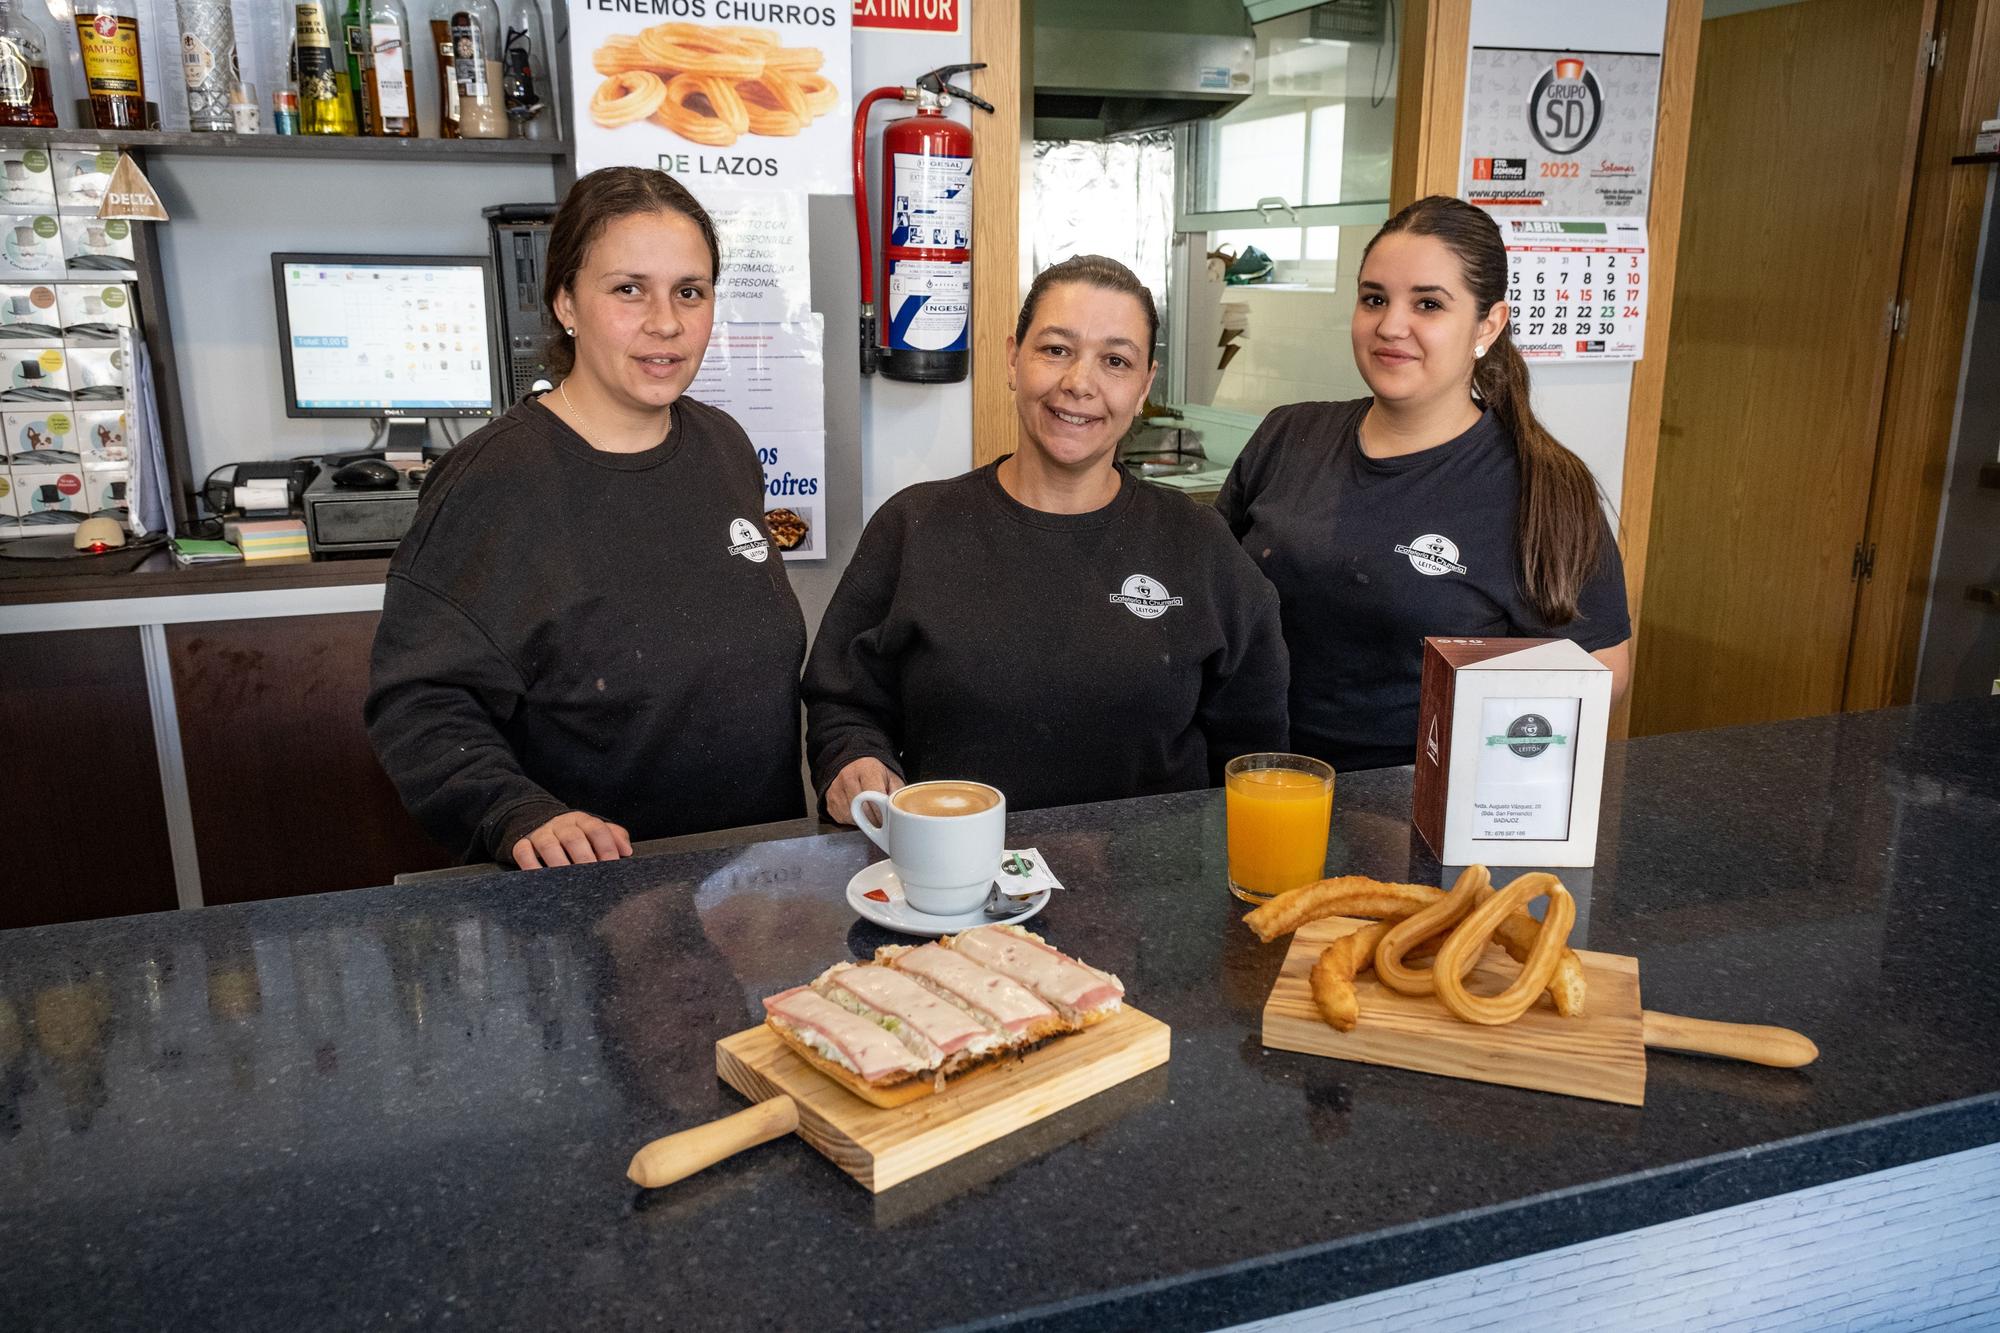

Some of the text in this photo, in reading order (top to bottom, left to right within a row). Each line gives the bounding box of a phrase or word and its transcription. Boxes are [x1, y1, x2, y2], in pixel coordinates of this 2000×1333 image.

[586, 0, 835, 26] TENEMOS CHURROS
[853, 0, 953, 20] EXTINTOR
[84, 45, 136, 56] PAMPERO
[1548, 85, 1586, 99] GRUPO
[1545, 99, 1584, 138] SD
[658, 154, 778, 176] DE LAZOS
[1540, 162, 1580, 177] 2022
[110, 193, 154, 206] DELTA
[1468, 189, 1545, 200] www.gruposd.com
[1525, 222, 1564, 234] ABRIL
[1586, 256, 1591, 267] 1
[1608, 256, 1615, 267] 2
[1630, 257, 1638, 268] 3
[728, 278, 779, 287] PERSONAL
[1512, 273, 1640, 285] 5 6 7 8 9 10
[1509, 289, 1639, 301] 12 13 14 15 16 17
[925, 304, 966, 312] INGESAL
[1530, 306, 1545, 318] 20
[1555, 306, 1567, 318] 21
[1577, 307, 1592, 318] 22
[1601, 306, 1615, 318] 23
[1623, 307, 1639, 318] 24
[1512, 323, 1521, 335] 6
[1529, 323, 1544, 335] 27
[1552, 323, 1567, 335] 28
[1576, 323, 1591, 335] 29
[1599, 323, 1614, 335] 30
